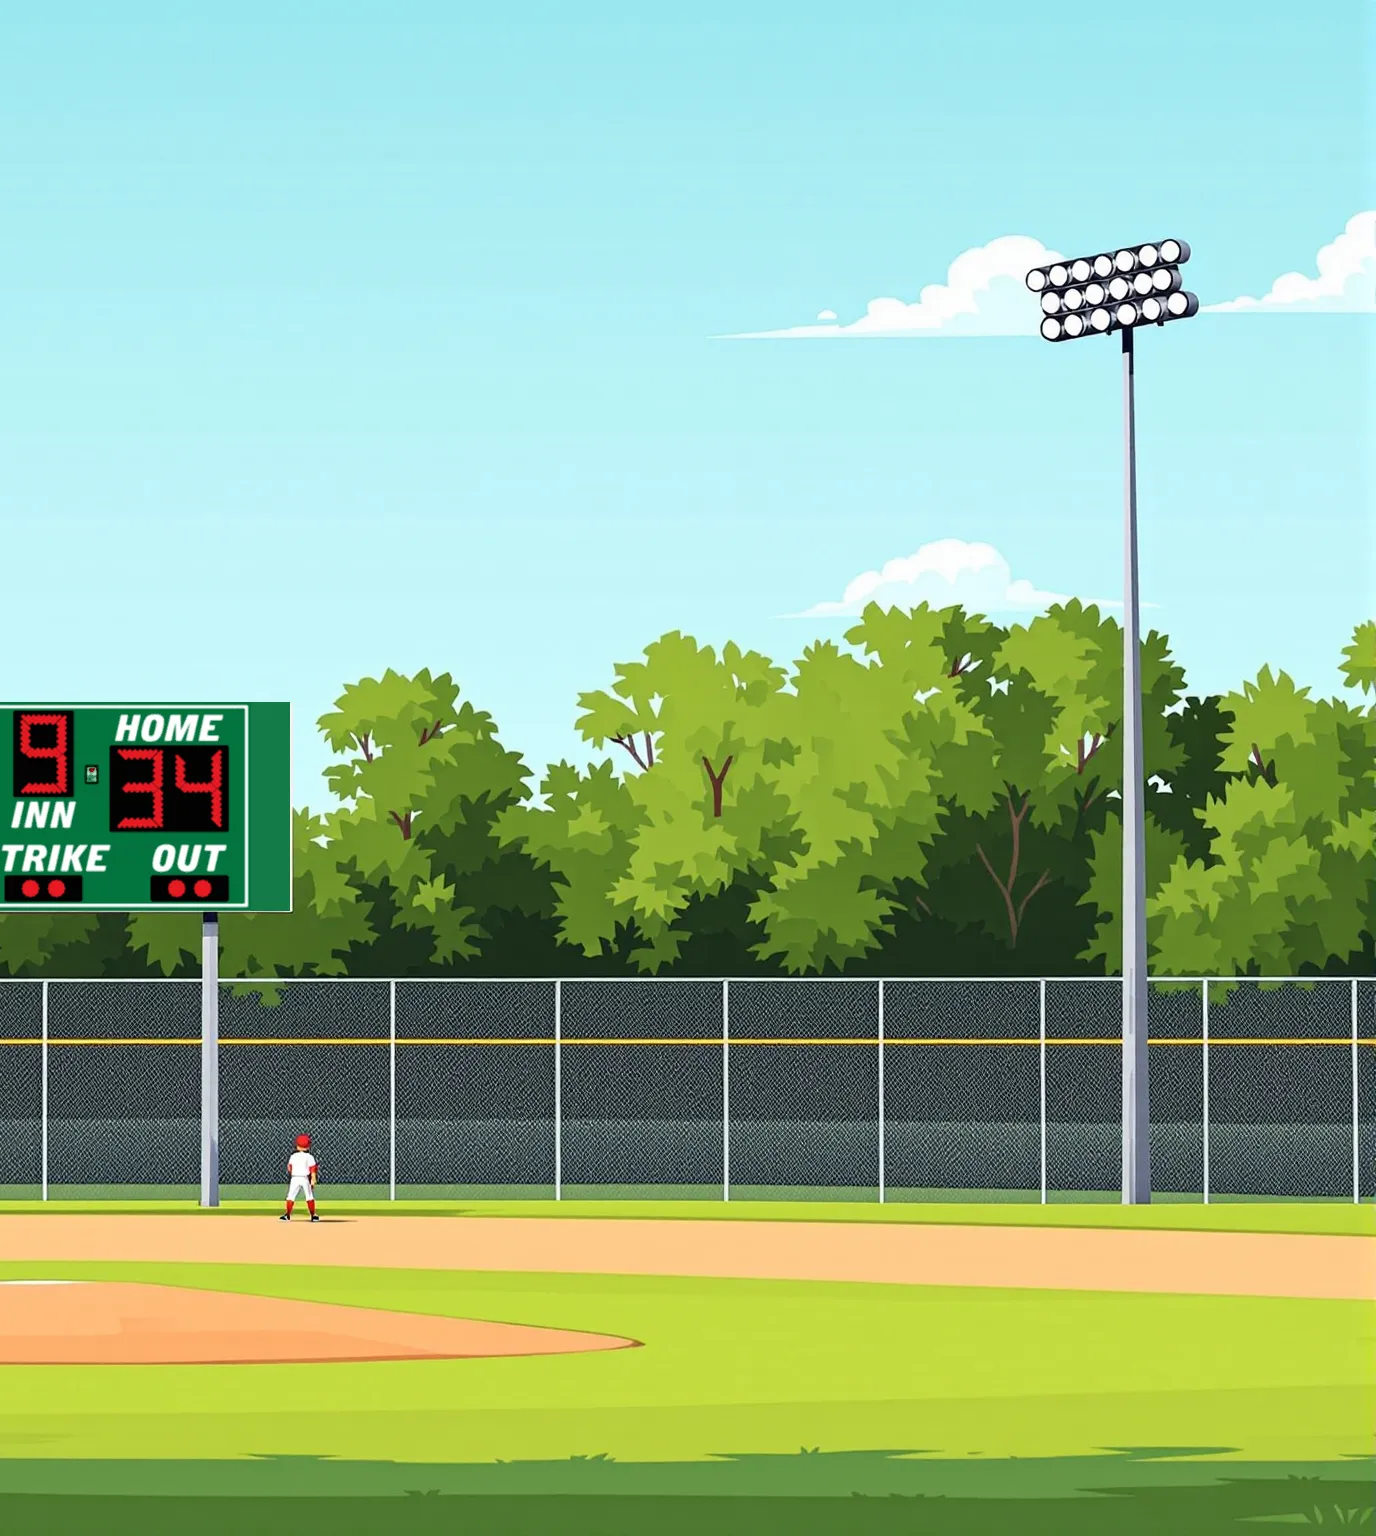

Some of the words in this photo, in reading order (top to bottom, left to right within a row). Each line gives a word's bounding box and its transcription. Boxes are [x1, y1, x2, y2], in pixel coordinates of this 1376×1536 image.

[115, 714, 223, 742] HOME
[20, 715, 67, 793] 9
[118, 750, 223, 828] 34
[11, 801, 76, 828] INN
[152, 844, 228, 872] OUT
